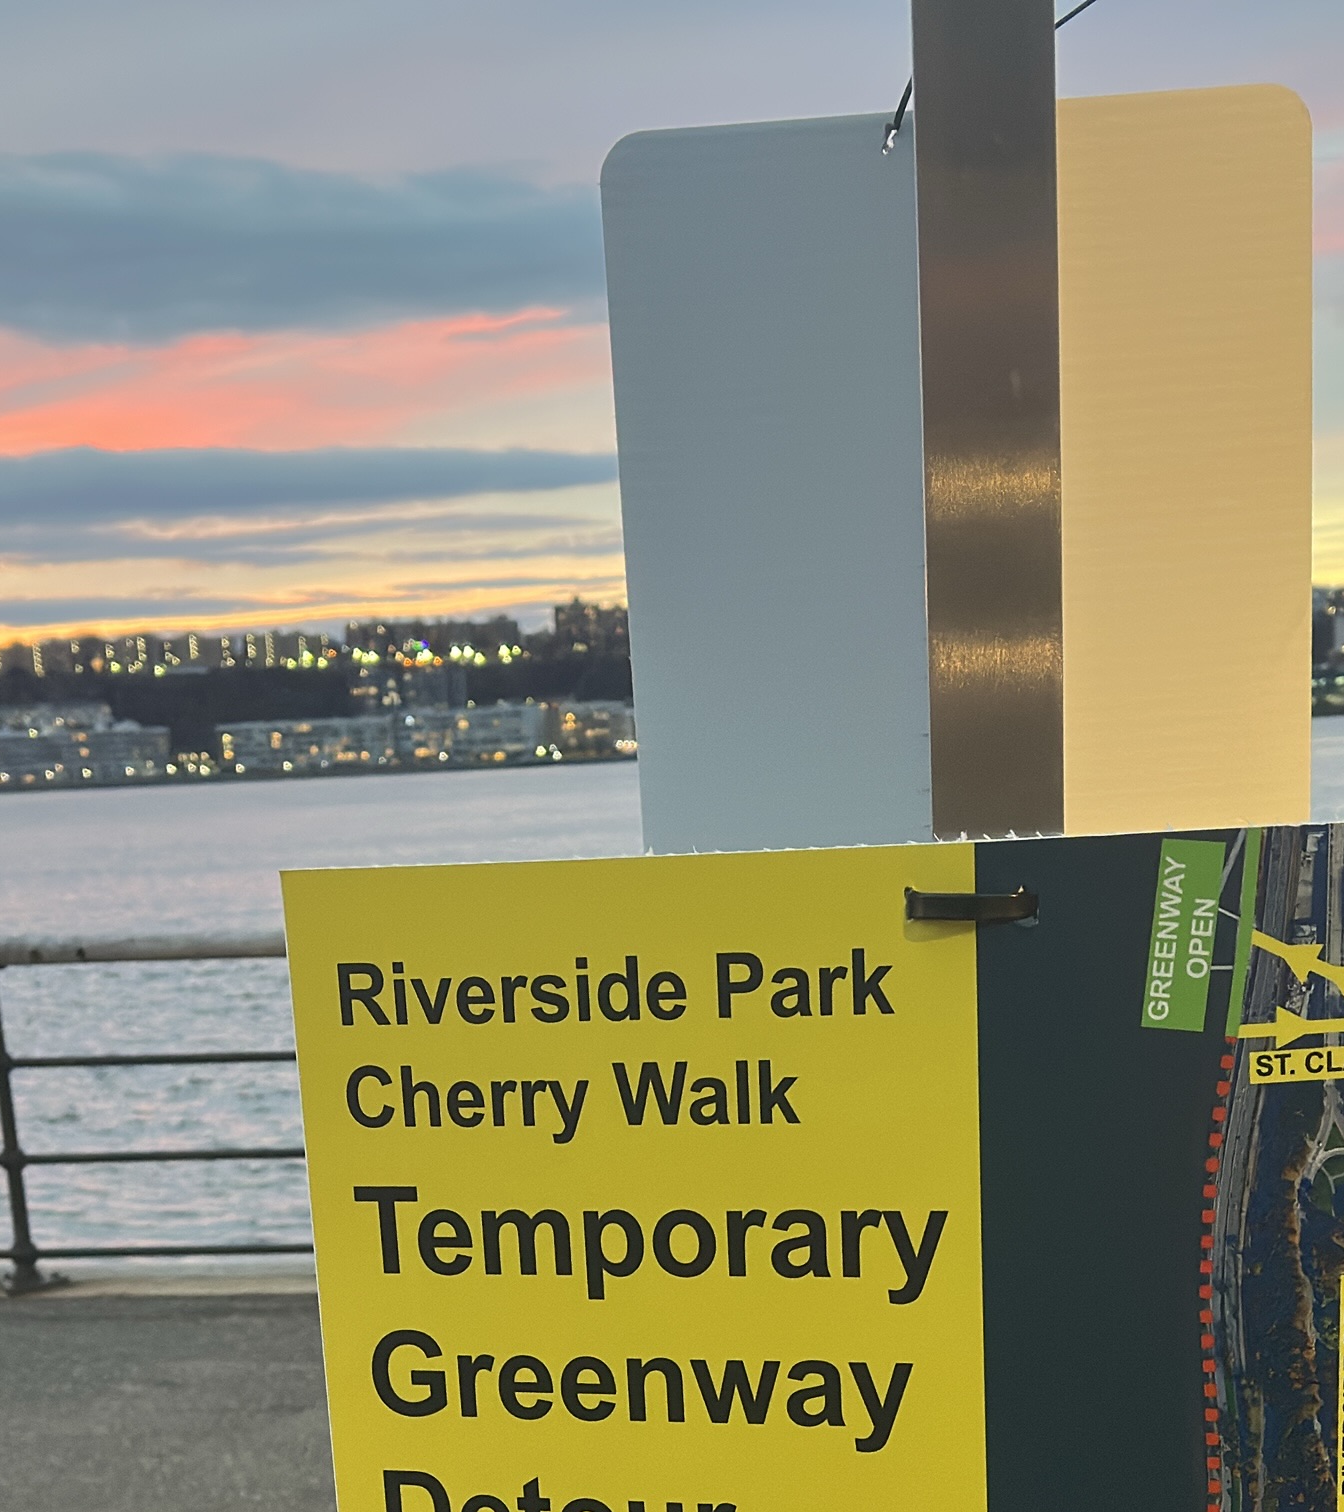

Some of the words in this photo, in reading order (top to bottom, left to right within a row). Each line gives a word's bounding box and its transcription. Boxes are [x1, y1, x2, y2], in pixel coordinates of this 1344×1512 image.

[1147, 856, 1187, 1021] GREENWAY
[1186, 898, 1217, 979] OPEN
[336, 955, 687, 1027] Riverside
[715, 947, 896, 1019] Park
[345, 1064, 590, 1145] Cherry
[611, 1059, 802, 1126] Walk
[1256, 1053, 1295, 1077] ST.
[353, 1185, 949, 1305] Temporary
[371, 1329, 914, 1453] Greenway
